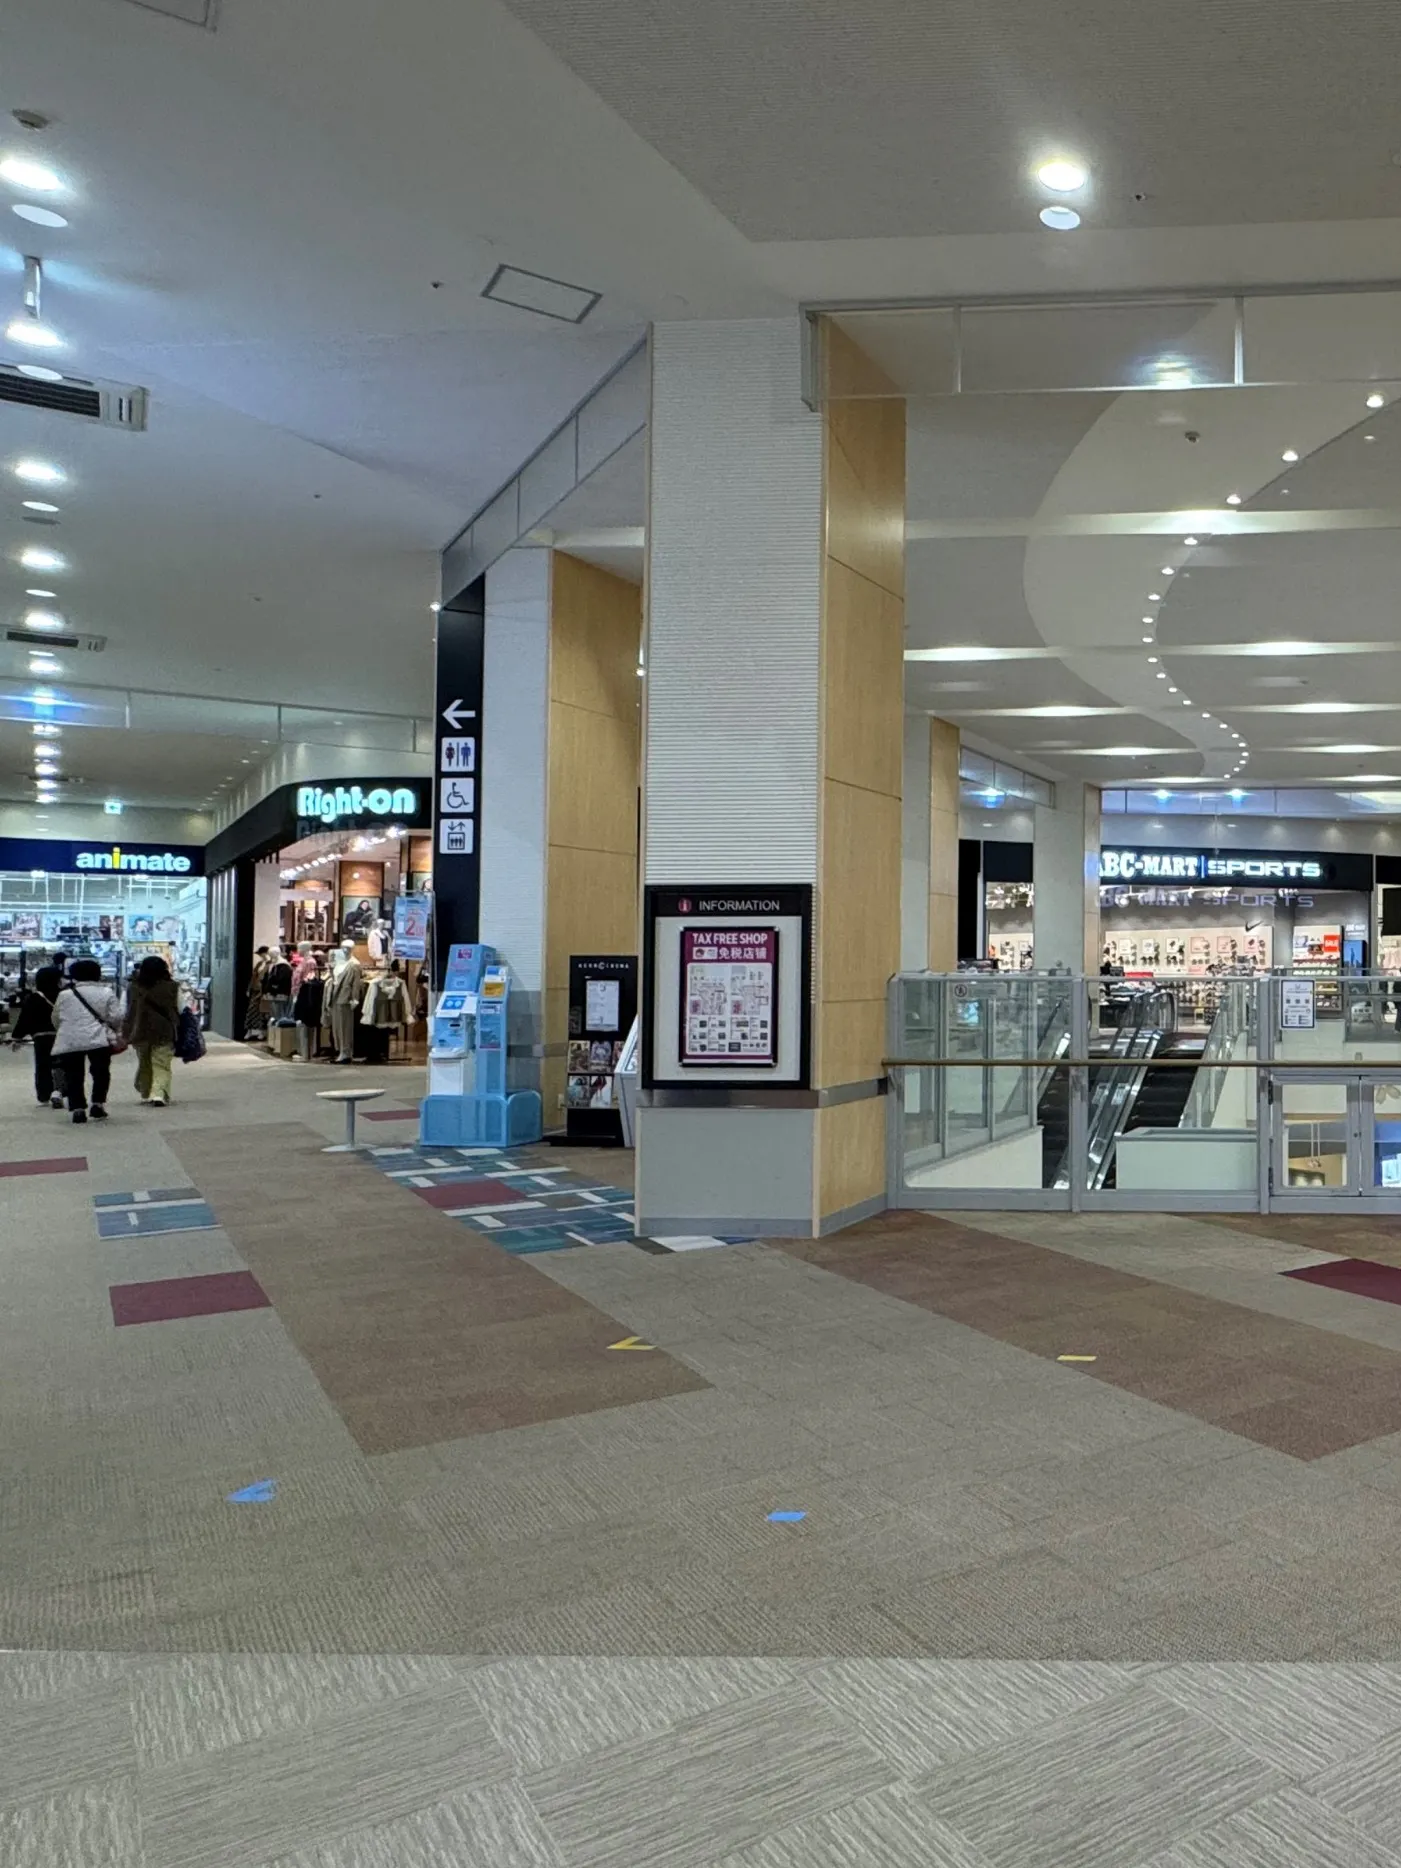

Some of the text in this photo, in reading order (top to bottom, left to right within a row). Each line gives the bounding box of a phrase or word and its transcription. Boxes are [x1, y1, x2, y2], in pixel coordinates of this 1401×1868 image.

[298, 786, 415, 822] Right-on
[76, 847, 191, 872] animate
[1207, 859, 1321, 877] SPORTS
[699, 899, 781, 911] INFORMATION
[692, 932, 768, 945] TAX FREE SHOP
